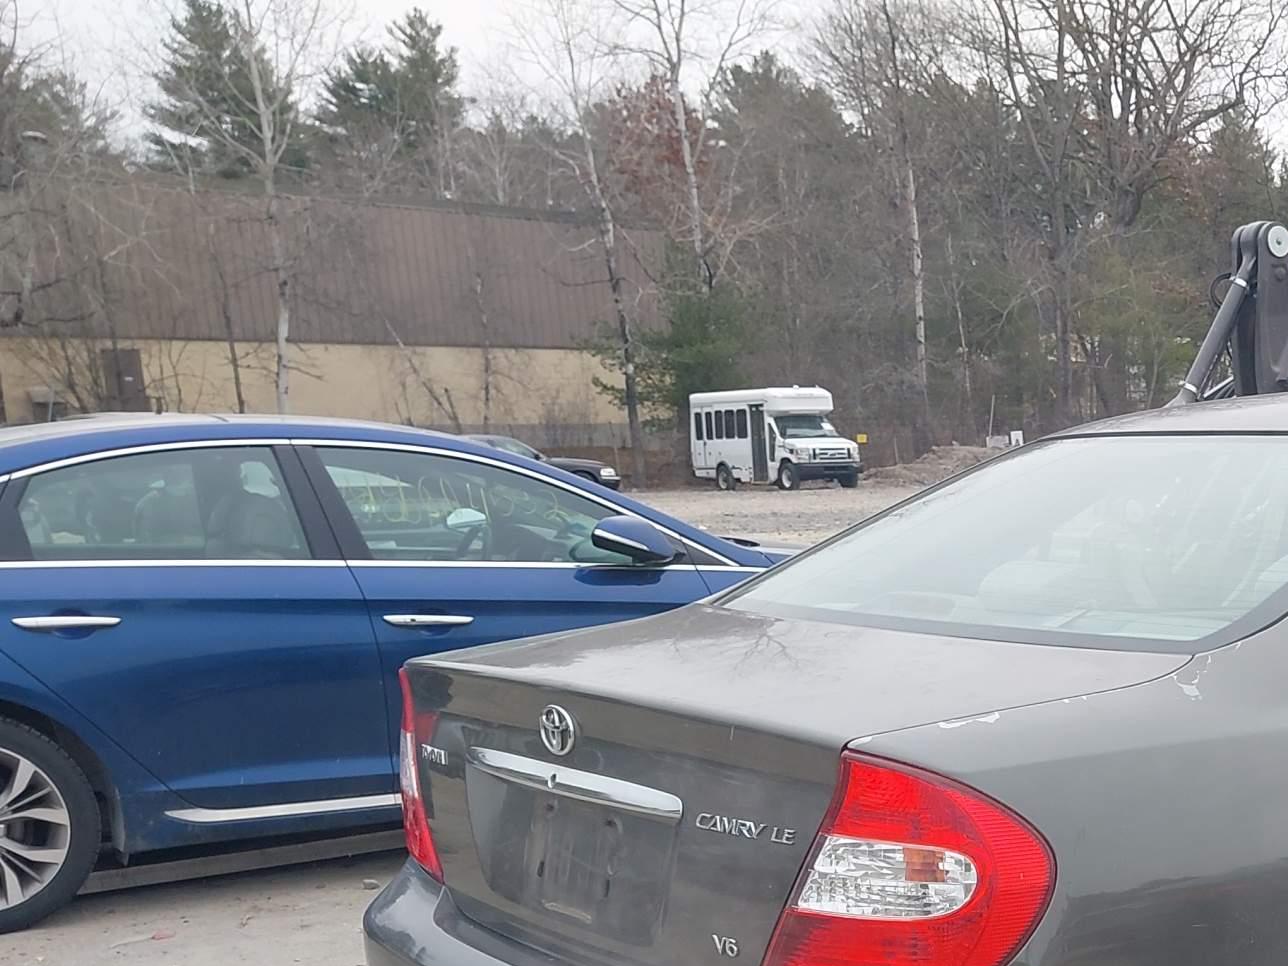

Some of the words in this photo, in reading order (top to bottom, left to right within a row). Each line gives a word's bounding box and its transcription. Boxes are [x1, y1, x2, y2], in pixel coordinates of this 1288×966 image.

[695, 812, 767, 839] CAMRY
[770, 826, 797, 845] LE
[712, 934, 738, 958] V6
